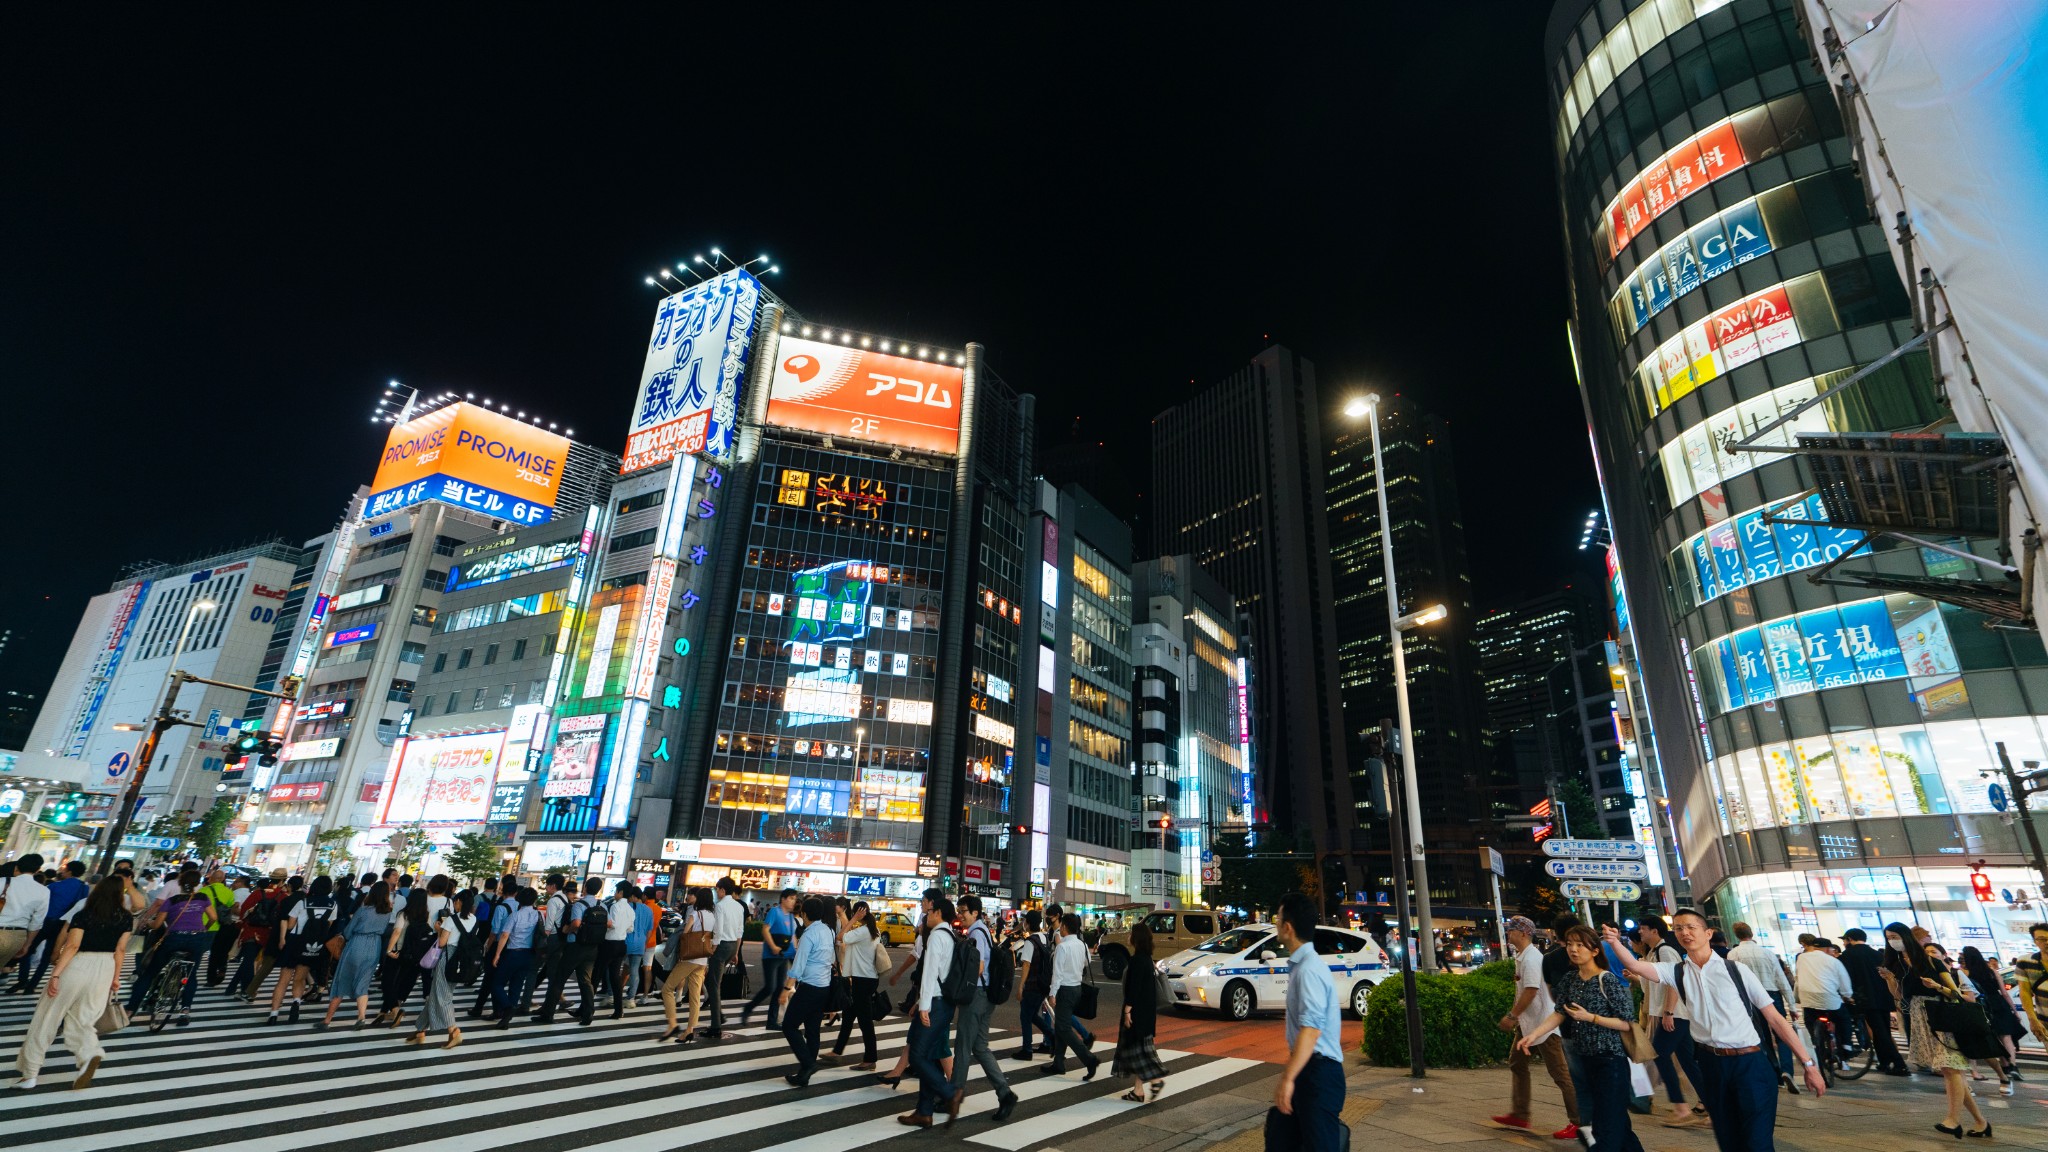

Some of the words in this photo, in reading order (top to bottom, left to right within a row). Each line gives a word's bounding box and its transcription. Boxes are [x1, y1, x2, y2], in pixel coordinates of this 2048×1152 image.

[673, 334, 695, 370] の
[707, 276, 760, 459] カラオケの鉄人
[638, 358, 708, 428] 鉄人
[866, 372, 952, 409] アコム
[849, 417, 880, 435] 2F
[383, 426, 448, 466] PROMISE
[416, 449, 440, 467] プロミス
[456, 429, 556, 477] PROMISE
[515, 468, 550, 488] プロミス
[371, 489, 405, 512] 当ビル
[407, 480, 428, 499] 6F
[441, 479, 504, 512] 当ビル
[512, 502, 544, 527] 6F
[653, 466, 722, 762] カラオケの鉄人
[638, 559, 676, 698] 100名収容大パーティールーム
[792, 648, 820, 663] 焼肉
[837, 654, 908, 670] 六歌仙
[1734, 624, 1879, 682] 新宿近視
[437, 747, 484, 768] カラオケ
[420, 774, 486, 808] まねきねこ
[495, 786, 526, 797] ビリヤード
[798, 779, 831, 788] OOTOYA
[787, 789, 834, 813] 大戸屋
[800, 851, 837, 865] アコム
[1586, 842, 1623, 850] 新宿西口駅
[635, 863, 663, 872] すみれ
[858, 876, 881, 892] 大戸屋
